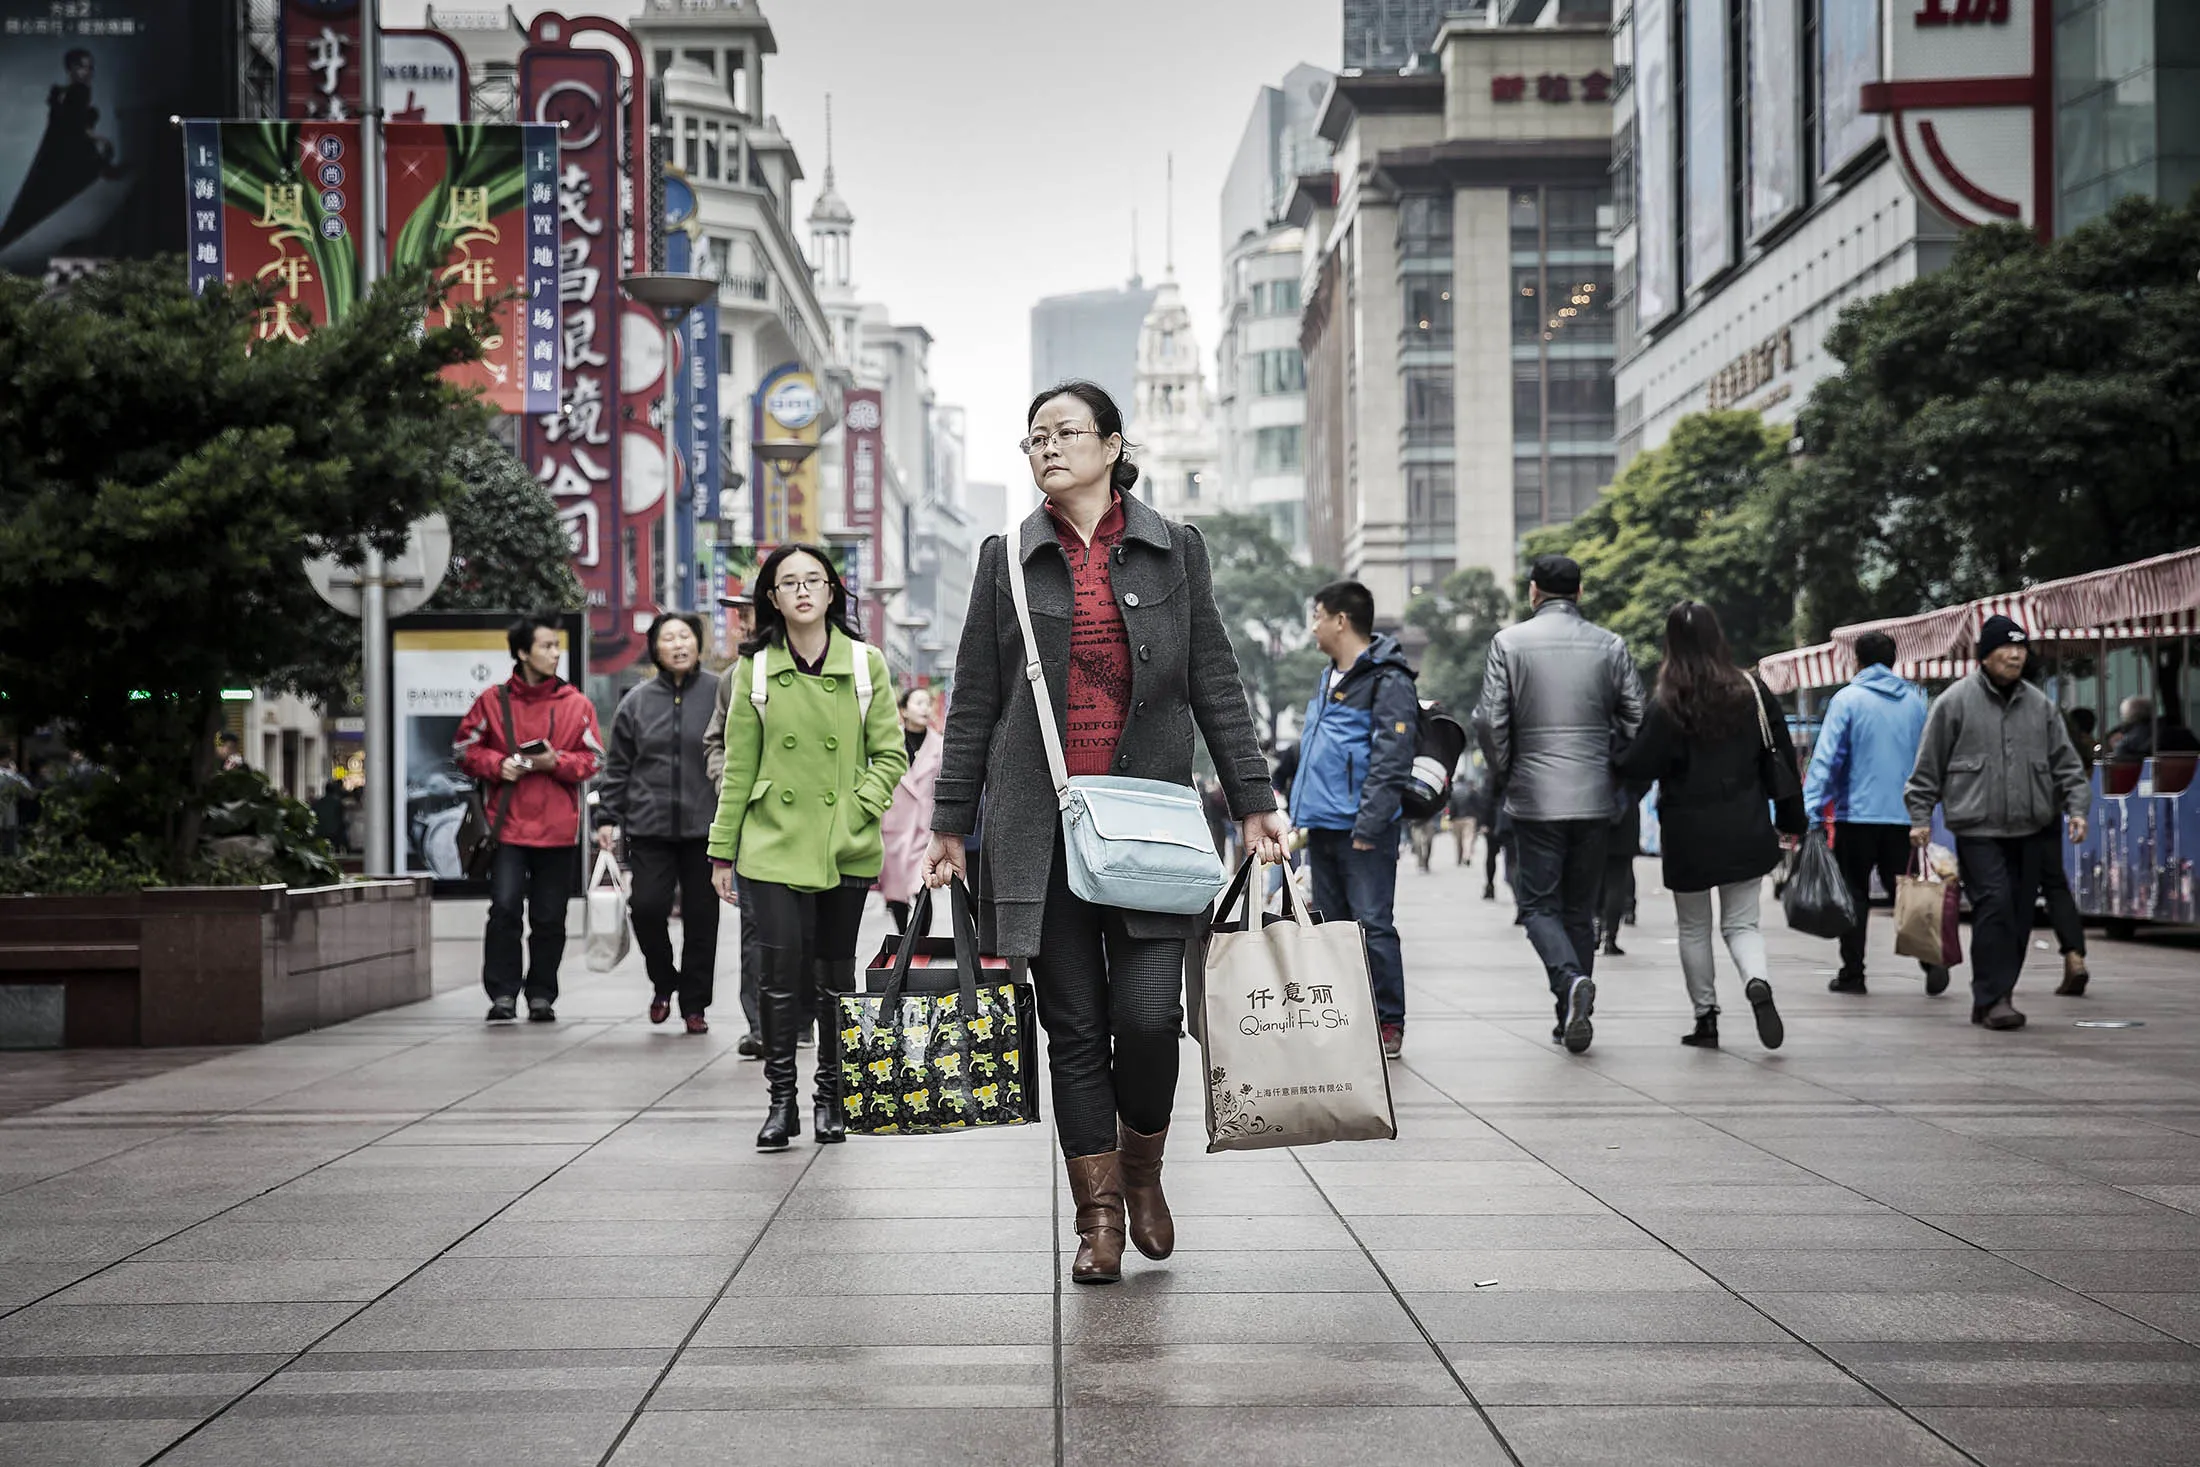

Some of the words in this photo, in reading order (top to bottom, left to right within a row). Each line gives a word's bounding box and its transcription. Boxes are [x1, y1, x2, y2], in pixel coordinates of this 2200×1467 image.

[531, 150, 555, 392] 上海置地广场商厦
[1246, 982, 1333, 1010] 仟意丽
[1239, 1011, 1295, 1036] Qianyili
[1298, 1009, 1319, 1030] Fu
[1322, 1008, 1349, 1029] Shi
[1255, 1082, 1353, 1098] 上海仟意丽服饰有限公司
